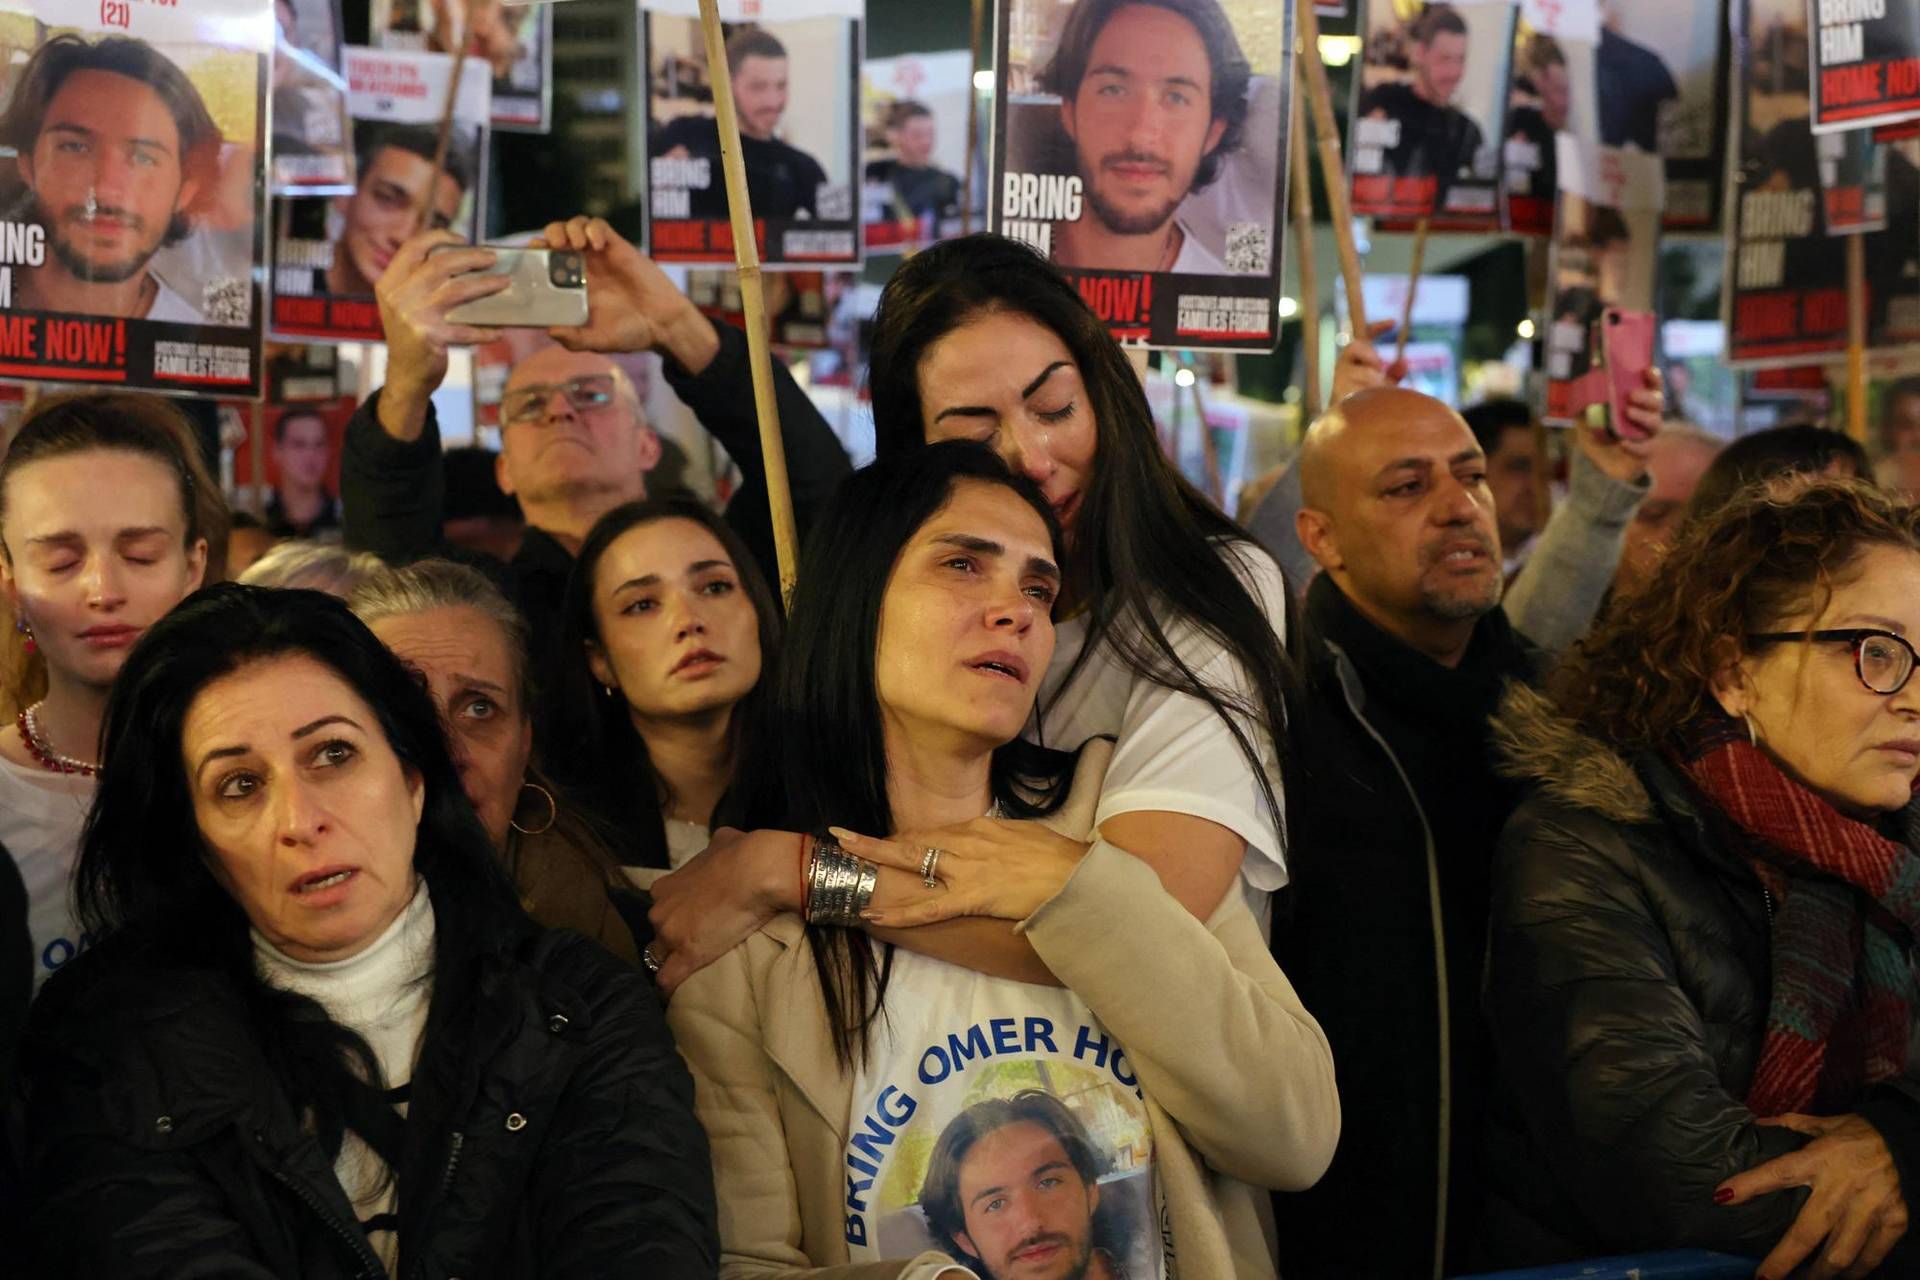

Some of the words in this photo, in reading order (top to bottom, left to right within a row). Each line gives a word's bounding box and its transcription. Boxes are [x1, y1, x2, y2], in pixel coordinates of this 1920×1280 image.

[101, 0, 129, 28] (21)
[1002, 172, 1083, 221] BRING
[46, 318, 126, 366] NOW!
[846, 1085, 918, 1247] BRING
[918, 1016, 1059, 1086] OMER
[1073, 1025, 1143, 1101] HO
